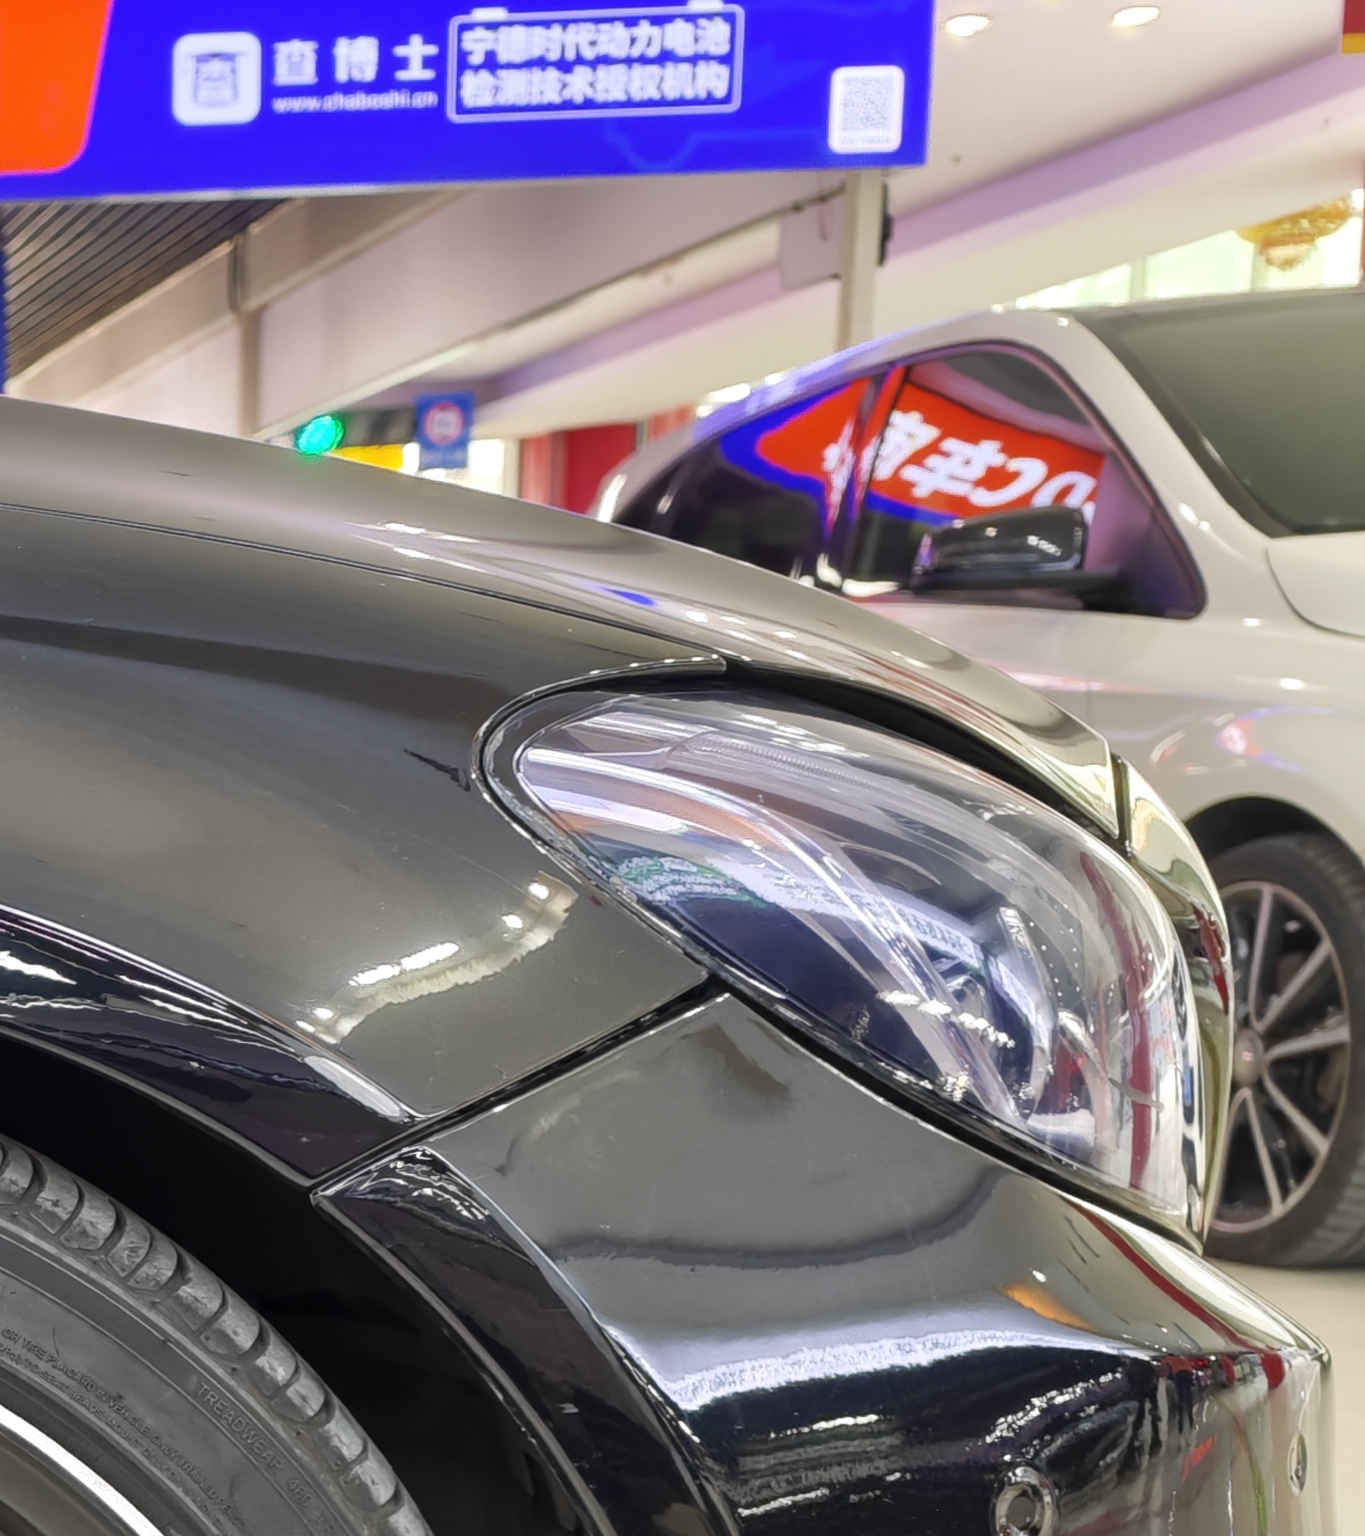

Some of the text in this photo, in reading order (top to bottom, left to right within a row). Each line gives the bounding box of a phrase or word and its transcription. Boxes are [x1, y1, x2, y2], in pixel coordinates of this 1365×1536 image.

[272, 34, 440, 86] 查博士
[461, 17, 731, 66] 宁德时代动力电池
[460, 59, 730, 108] 检测技术授权机构
[0, 1324, 24, 1344] OR
[104, 1393, 154, 1437] VEHICLE
[190, 1380, 287, 1474] TREADWEAR
